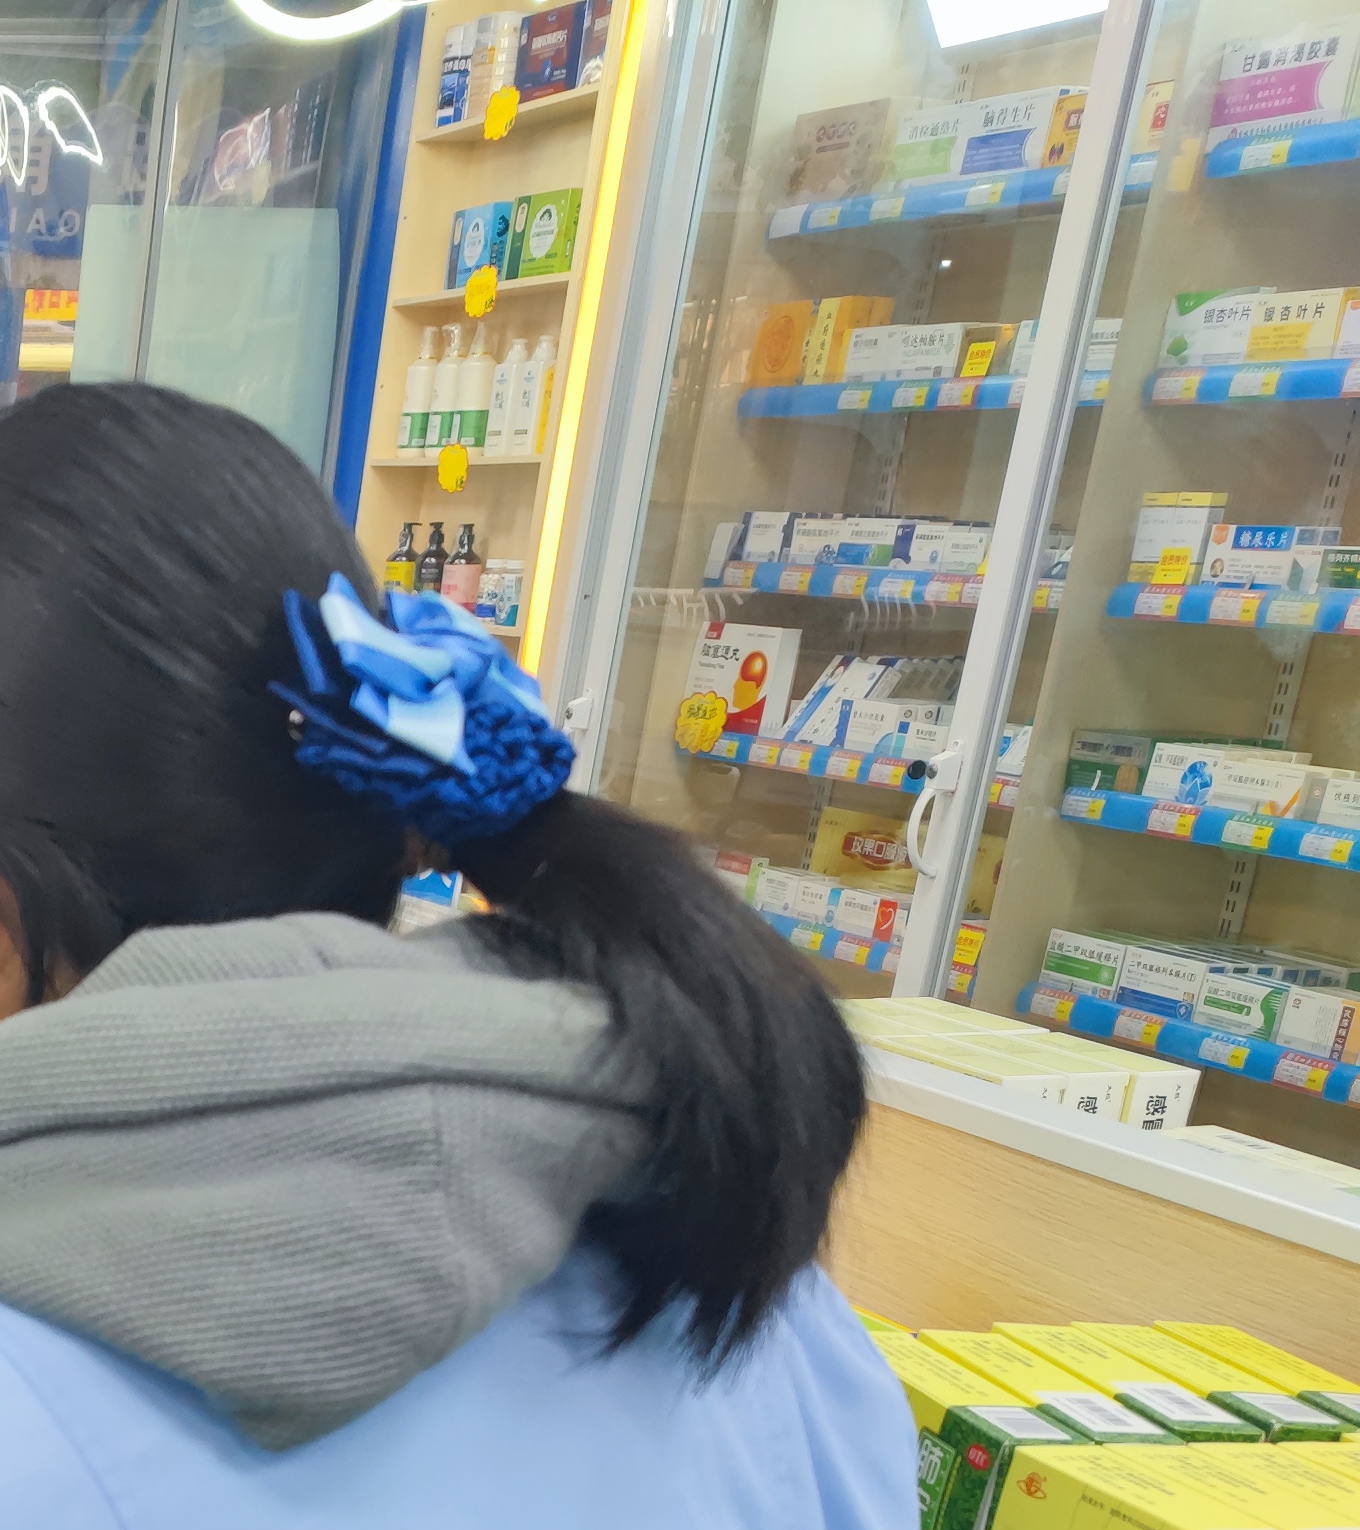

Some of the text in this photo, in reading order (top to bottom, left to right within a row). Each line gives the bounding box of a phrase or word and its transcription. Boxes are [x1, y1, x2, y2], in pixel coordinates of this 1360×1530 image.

[1203, 306, 1252, 324] 银杏叶片
[1264, 303, 1325, 323] 银杏叶片
